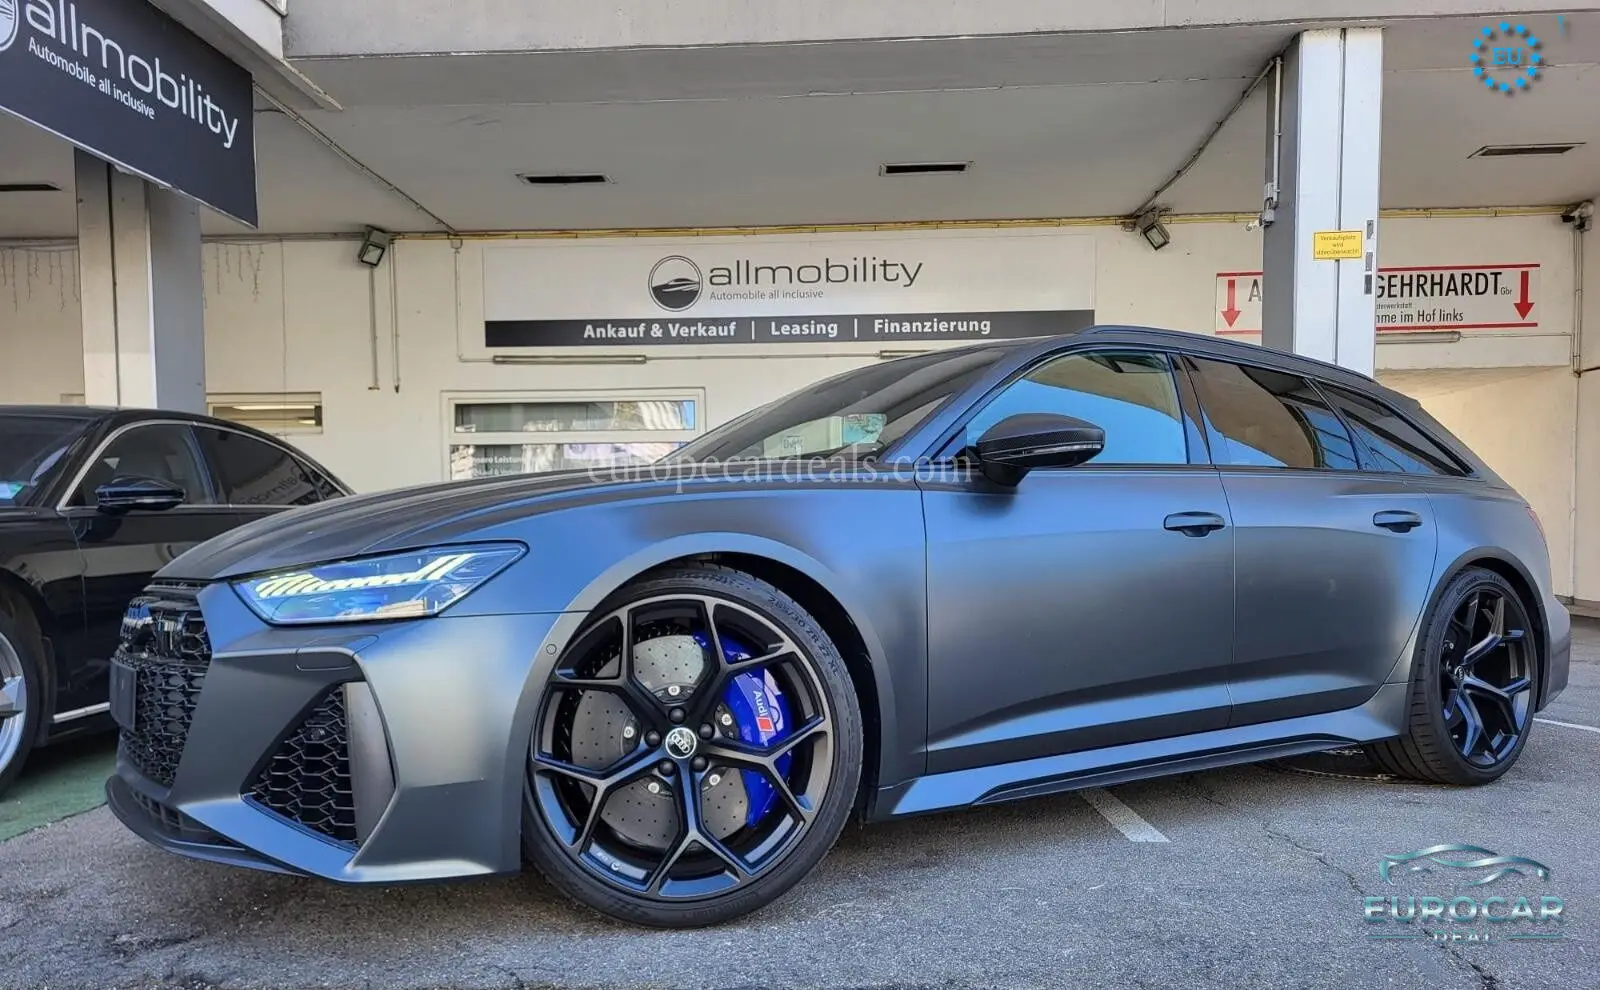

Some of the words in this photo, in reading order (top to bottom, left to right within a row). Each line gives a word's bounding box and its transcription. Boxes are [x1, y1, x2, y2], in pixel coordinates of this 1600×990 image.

[26, 0, 238, 148] allmobility
[29, 37, 95, 87] Automobile
[98, 78, 111, 95] all
[113, 84, 155, 119] inclusive
[709, 257, 923, 288] allmobility
[709, 290, 766, 301] Automobile
[768, 289, 780, 300] all
[782, 289, 824, 299] inclusive
[583, 323, 646, 339] Ankauf
[650, 323, 663, 338] &
[667, 322, 736, 338] Verkauf
[770, 321, 839, 338] Leasing
[873, 318, 991, 334] Finanzierung
[1400, 310, 1414, 323] im
[1417, 308, 1437, 323] Hof
[1440, 307, 1464, 322] links
[752, 690, 769, 717] Audi
